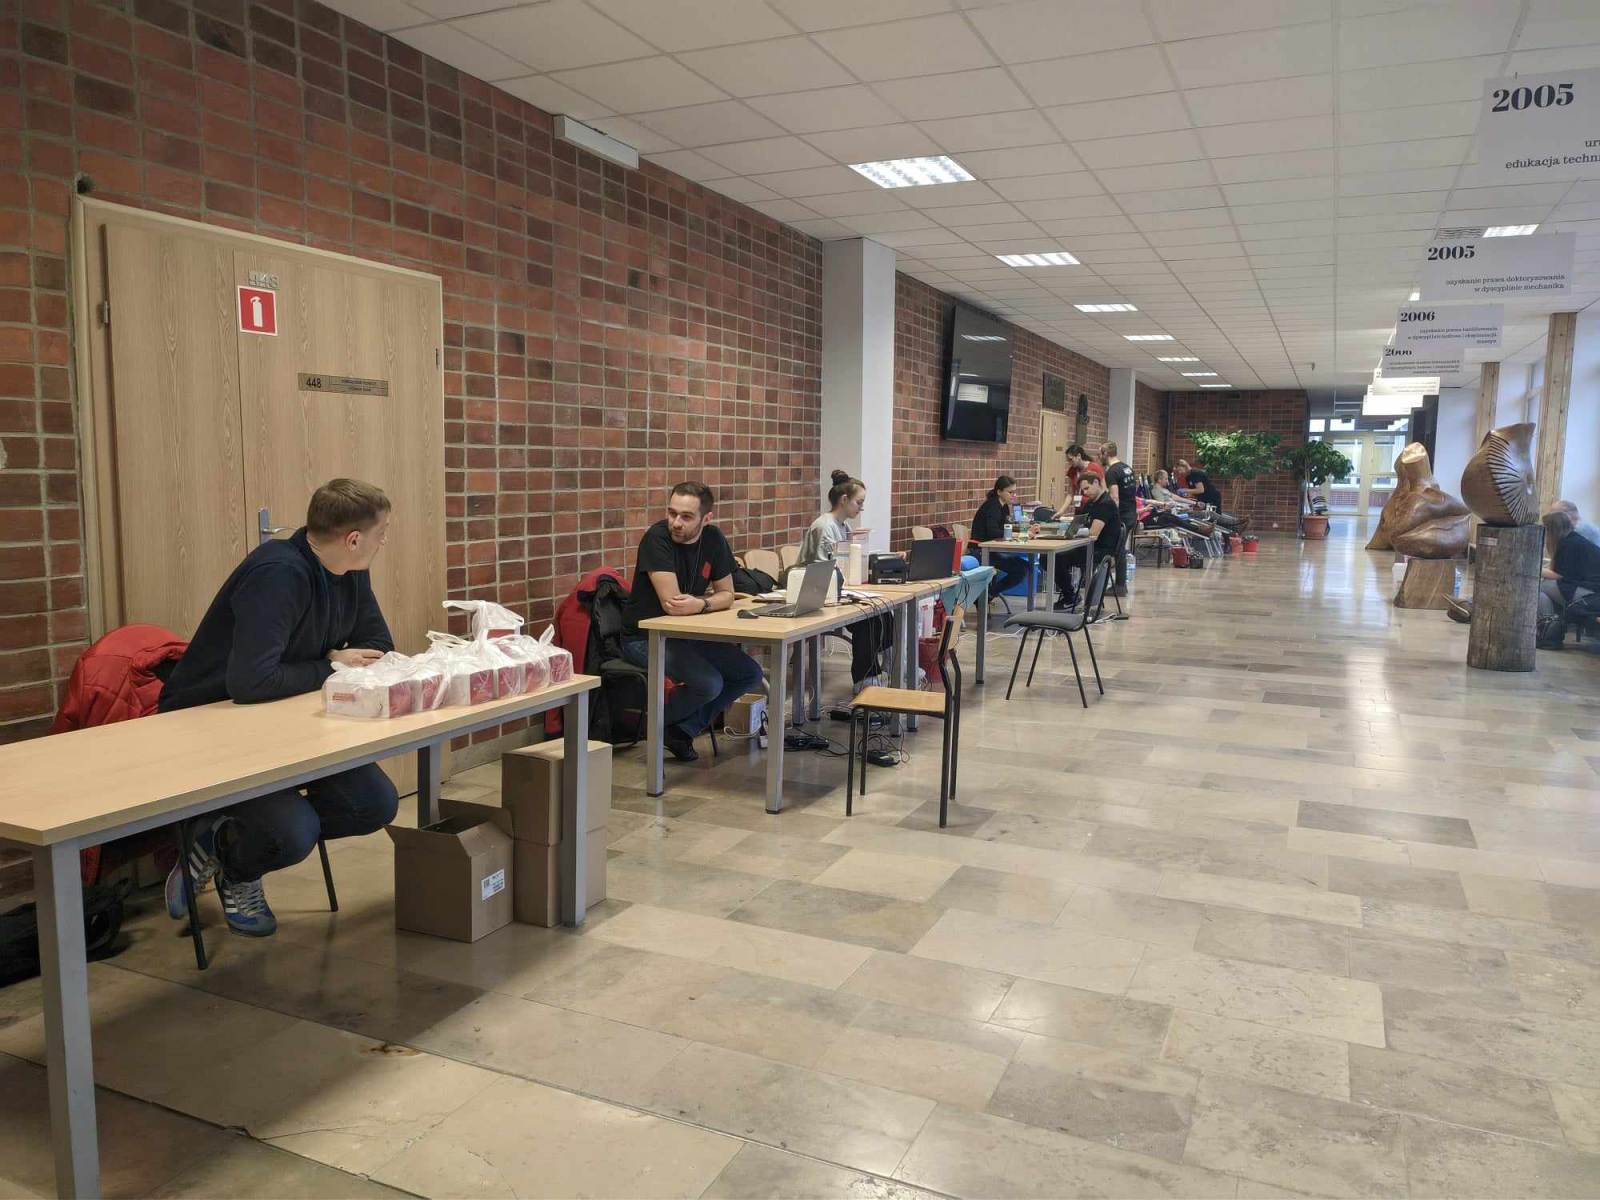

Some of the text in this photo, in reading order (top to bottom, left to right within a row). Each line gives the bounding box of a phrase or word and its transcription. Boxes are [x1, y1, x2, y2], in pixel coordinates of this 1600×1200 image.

[1491, 83, 1574, 113] 2005
[1584, 139, 1600, 148] ur
[1505, 156, 1561, 169] edukacja
[1427, 245, 1475, 261] 2005
[1400, 311, 1435, 322] 2006
[306, 377, 321, 389] 448
